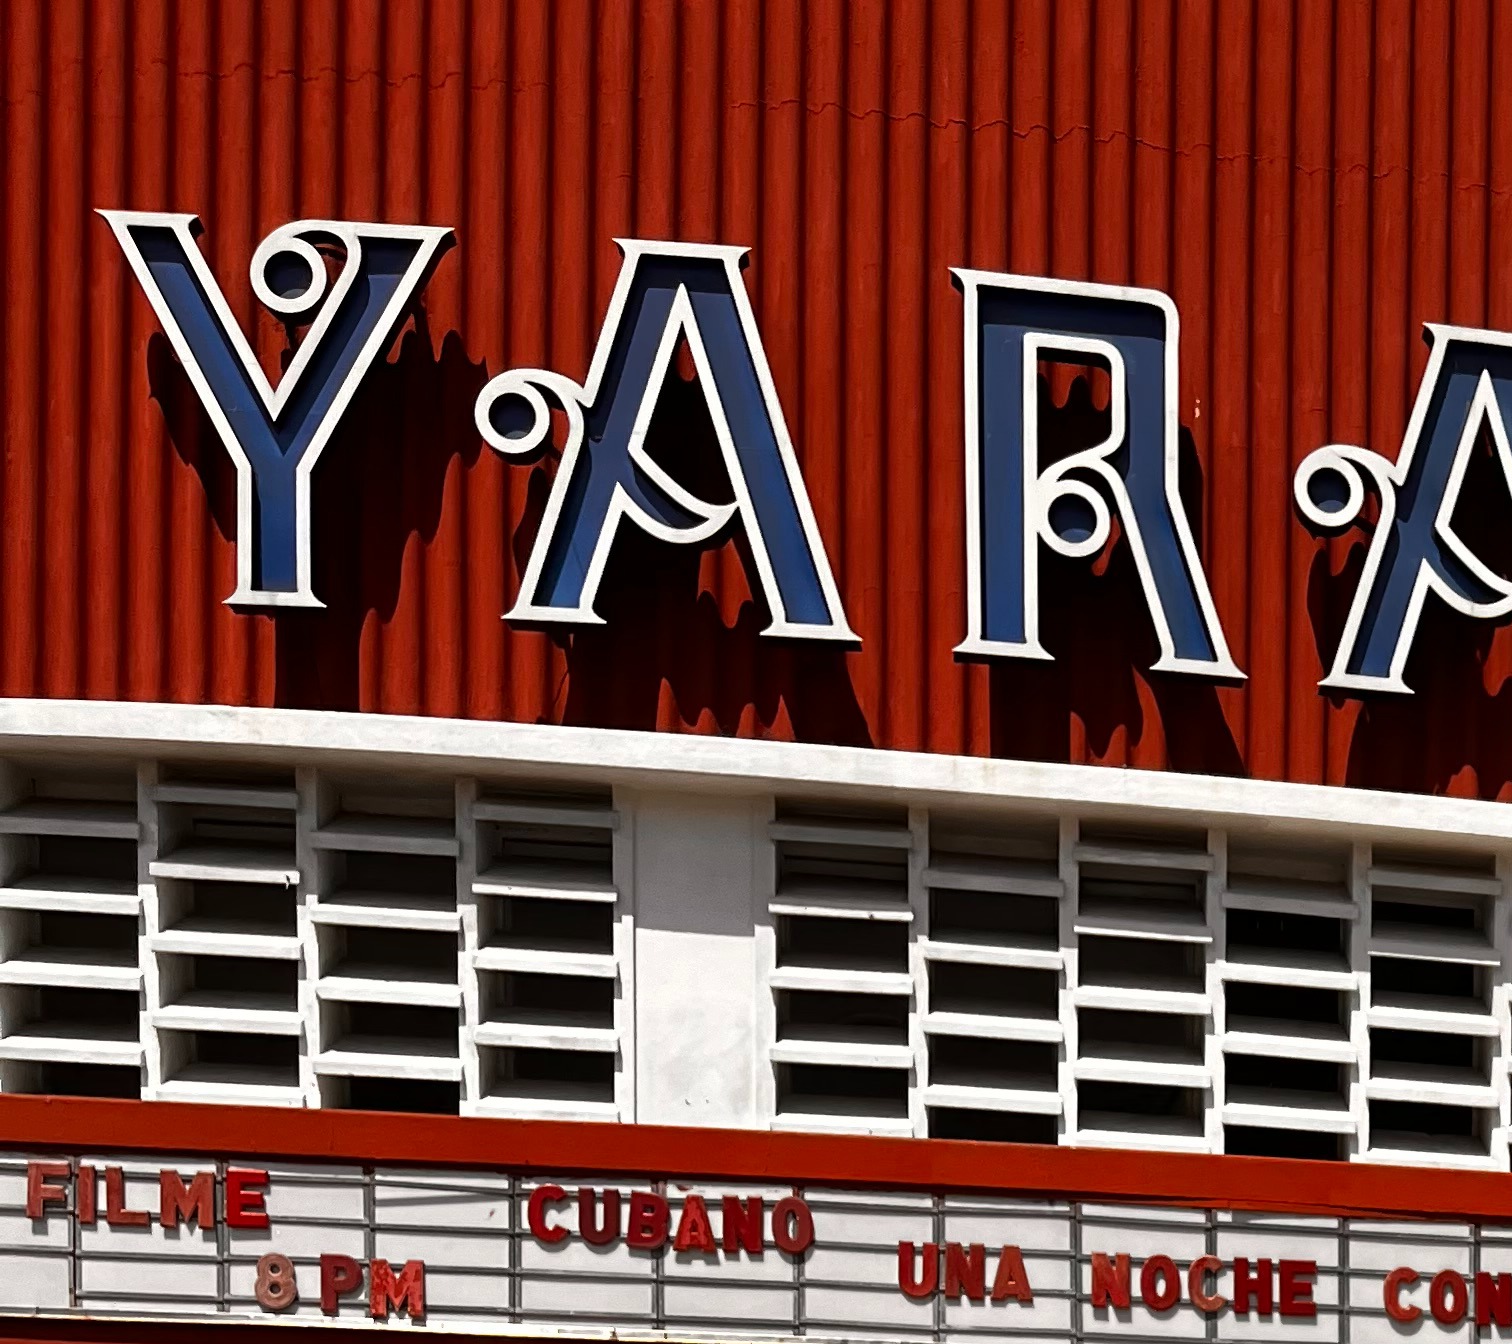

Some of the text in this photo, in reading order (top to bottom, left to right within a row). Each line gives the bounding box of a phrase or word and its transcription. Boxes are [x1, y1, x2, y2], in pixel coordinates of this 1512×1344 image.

[26, 1161, 270, 1229] FILME
[527, 1184, 815, 1255] CUBANO
[898, 1241, 1033, 1302] UNA
[1091, 1252, 1317, 1317] NOCHE
[254, 1253, 426, 1319] 8 PM
